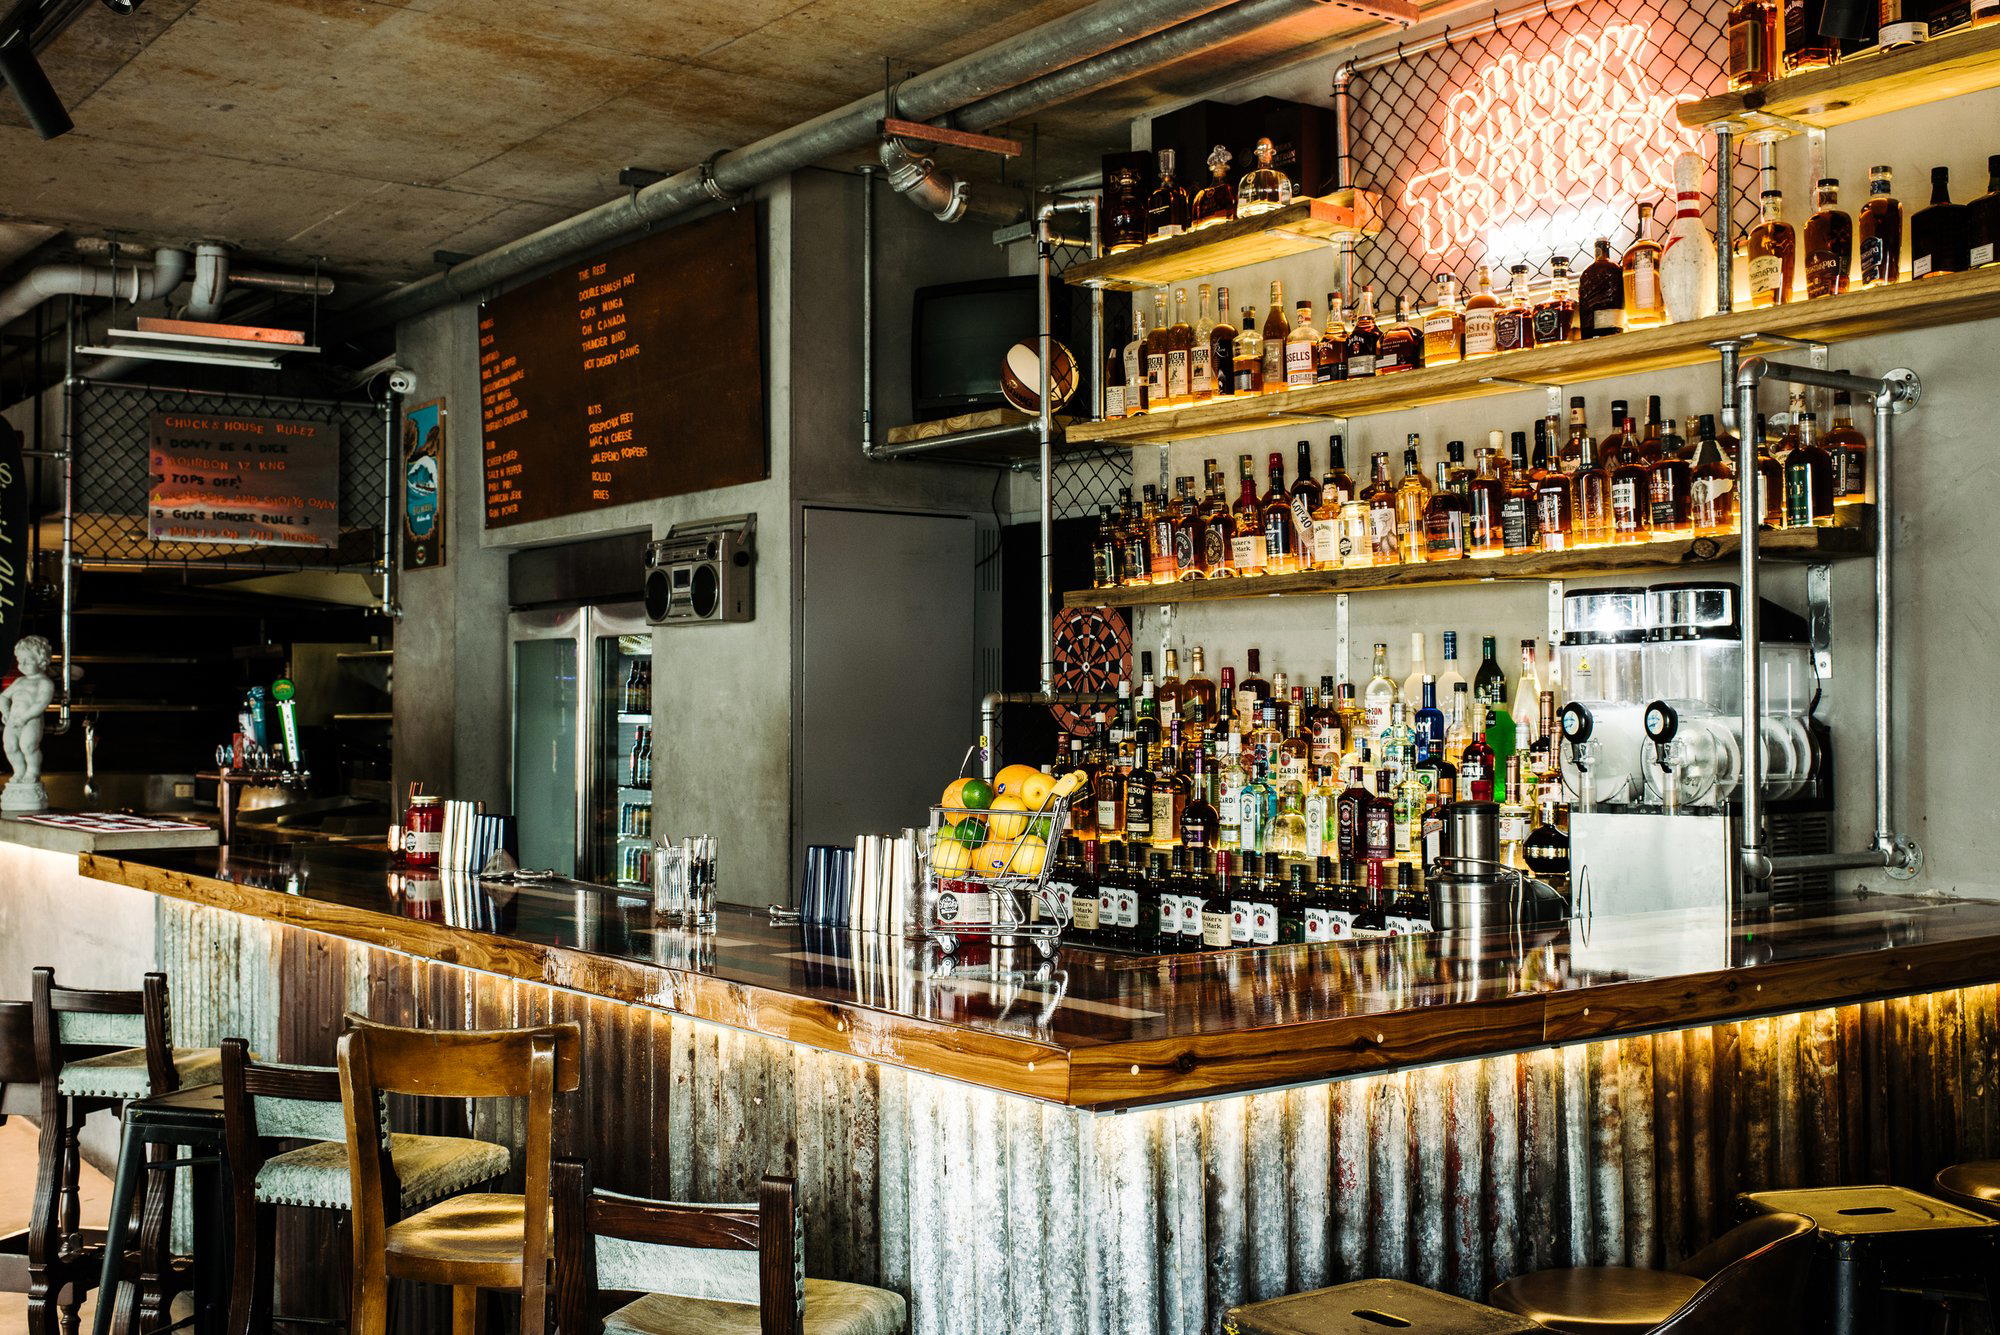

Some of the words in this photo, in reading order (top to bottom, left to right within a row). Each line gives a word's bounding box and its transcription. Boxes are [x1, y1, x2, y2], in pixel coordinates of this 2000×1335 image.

[582, 325, 592, 336] OH
[598, 313, 626, 331] CANADA
[611, 330, 626, 344] BIRD
[620, 344, 640, 359] DAWG
[224, 422, 265, 435] HOUSE
[276, 424, 316, 437] RULEZ
[611, 430, 633, 443] CHEESE
[170, 438, 212, 450] DON'T
[218, 441, 235, 452] BE
[243, 442, 253, 453] A
[259, 443, 288, 454] DICK
[172, 474, 205, 486] TOPS
[1292, 500, 1304, 517] LOT
[1300, 516, 1313, 528] 40
[1504, 503, 1519, 511] Evan
[155, 509, 164, 519] 5
[261, 514, 294, 525] RULE
